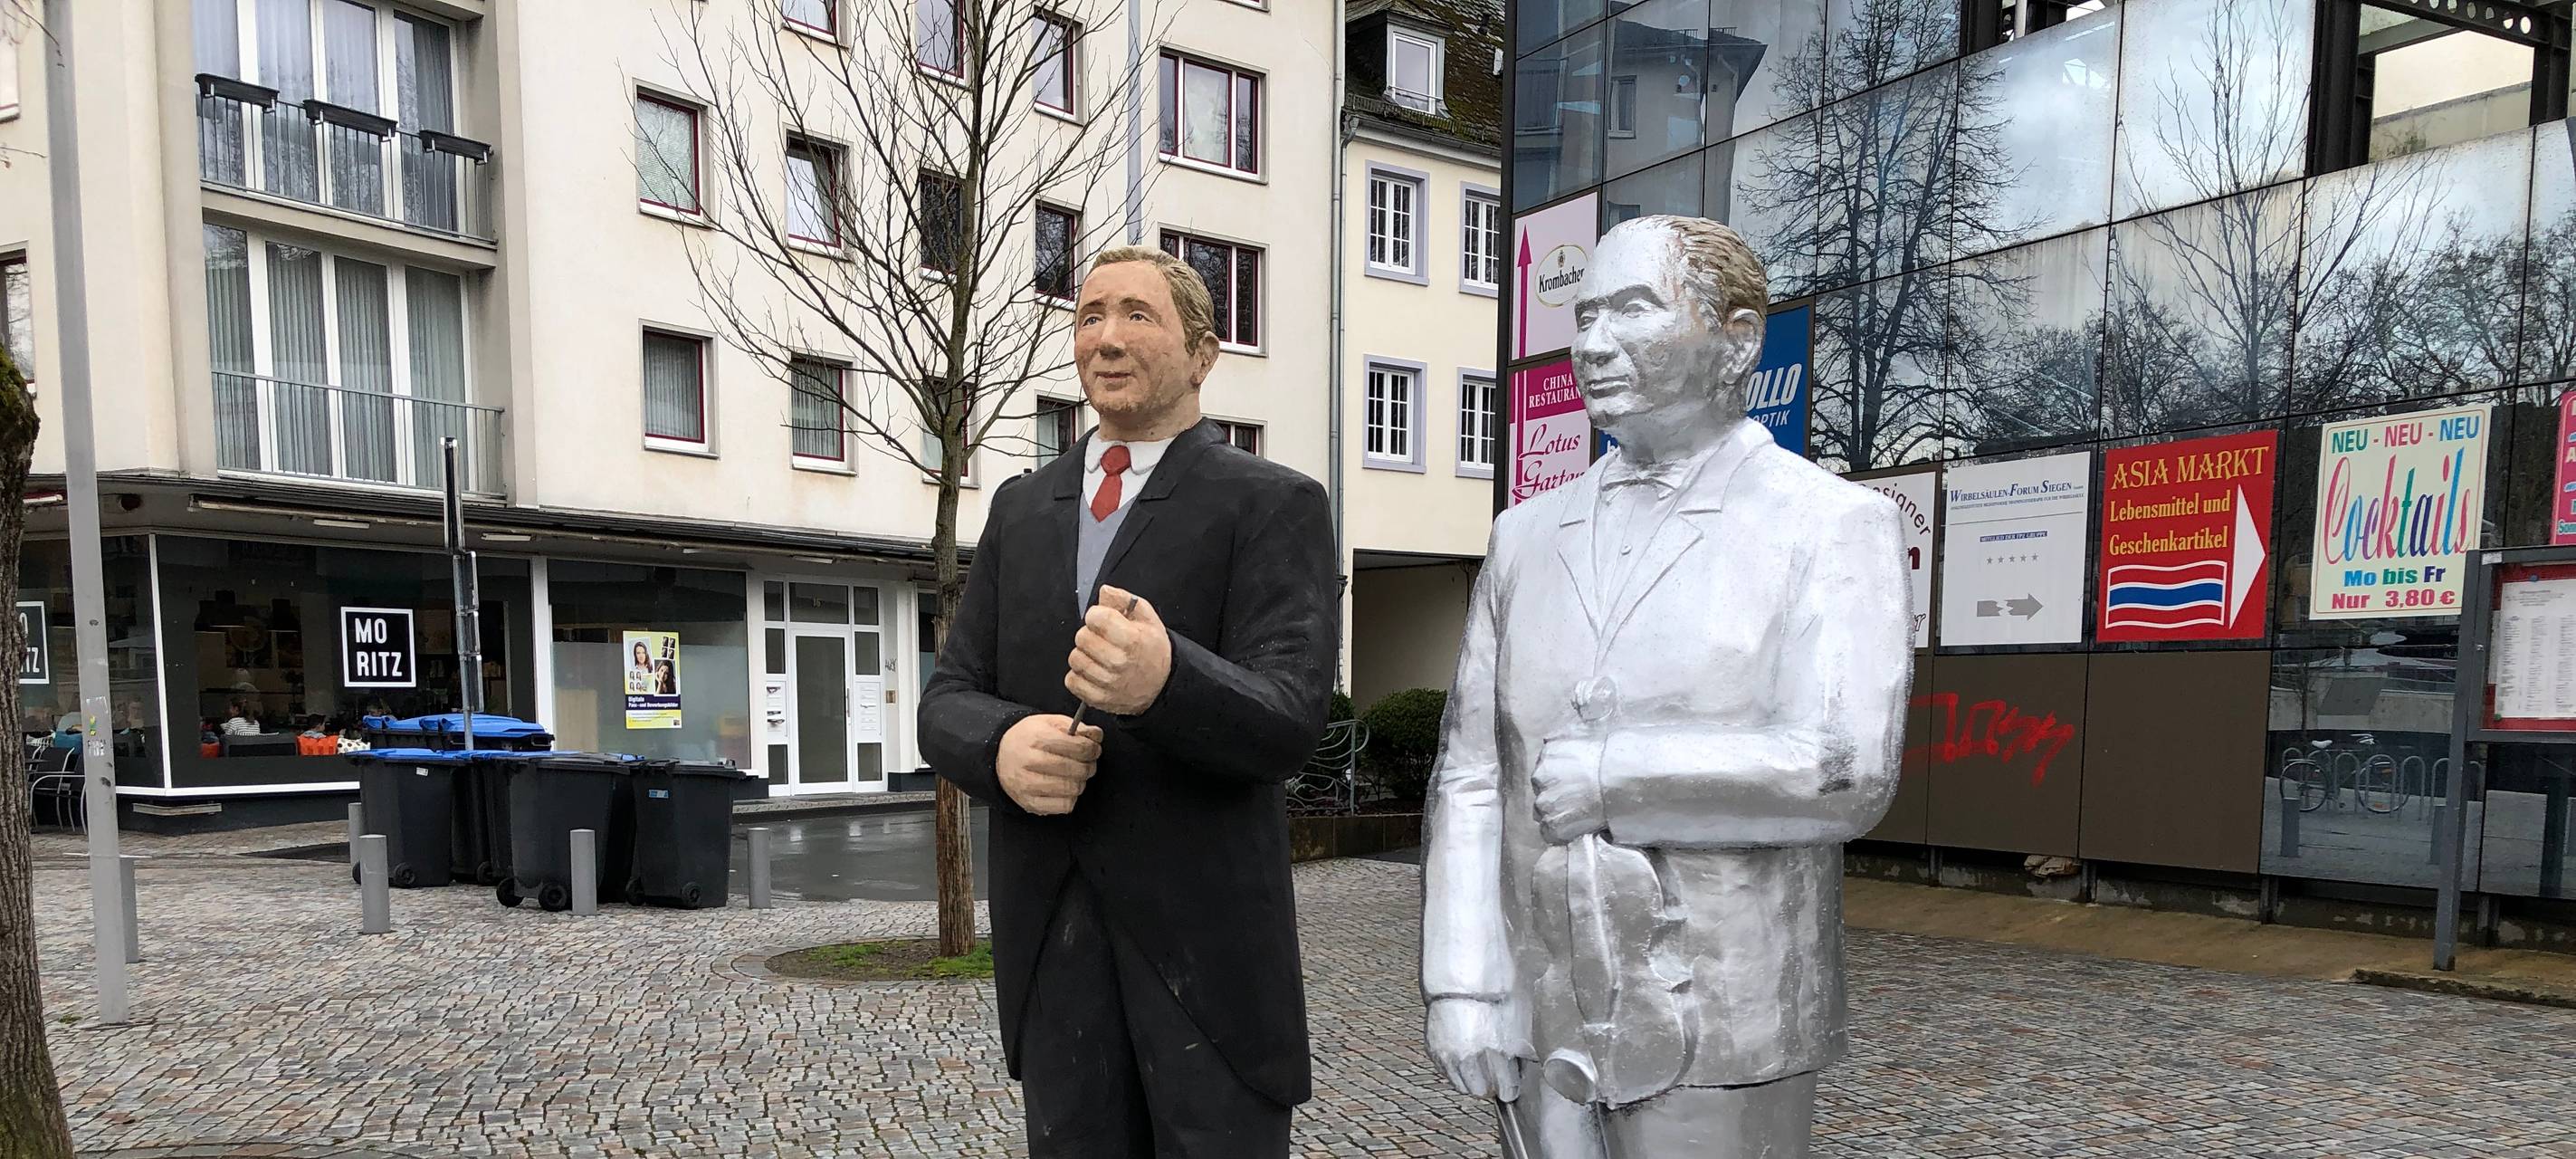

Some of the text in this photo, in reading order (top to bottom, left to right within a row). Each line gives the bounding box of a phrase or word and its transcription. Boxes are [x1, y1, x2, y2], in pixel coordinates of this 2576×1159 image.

[1539, 265, 1585, 293] Krombacher
[1543, 372, 1574, 391] CHINA
[1745, 363, 1802, 412] OLLO
[1528, 386, 1582, 409] RESTAURAN
[1518, 423, 1581, 460] Lotus
[2332, 428, 2369, 454] NEU
[2384, 422, 2423, 447] NEU
[2439, 416, 2480, 442] NEU
[2111, 446, 2269, 490] ASIA MARKT
[2040, 480, 2072, 494] SIEGEN
[2110, 489, 2231, 522] Lebensmittel und
[2323, 445, 2472, 565] Cocktails
[2109, 525, 2228, 556] Geschenkartikel
[2344, 566, 2446, 587] Mo bis Fr
[2332, 589, 2456, 609] Nur 3,80 €
[355, 618, 387, 644] MO
[357, 651, 403, 677] RITZ
